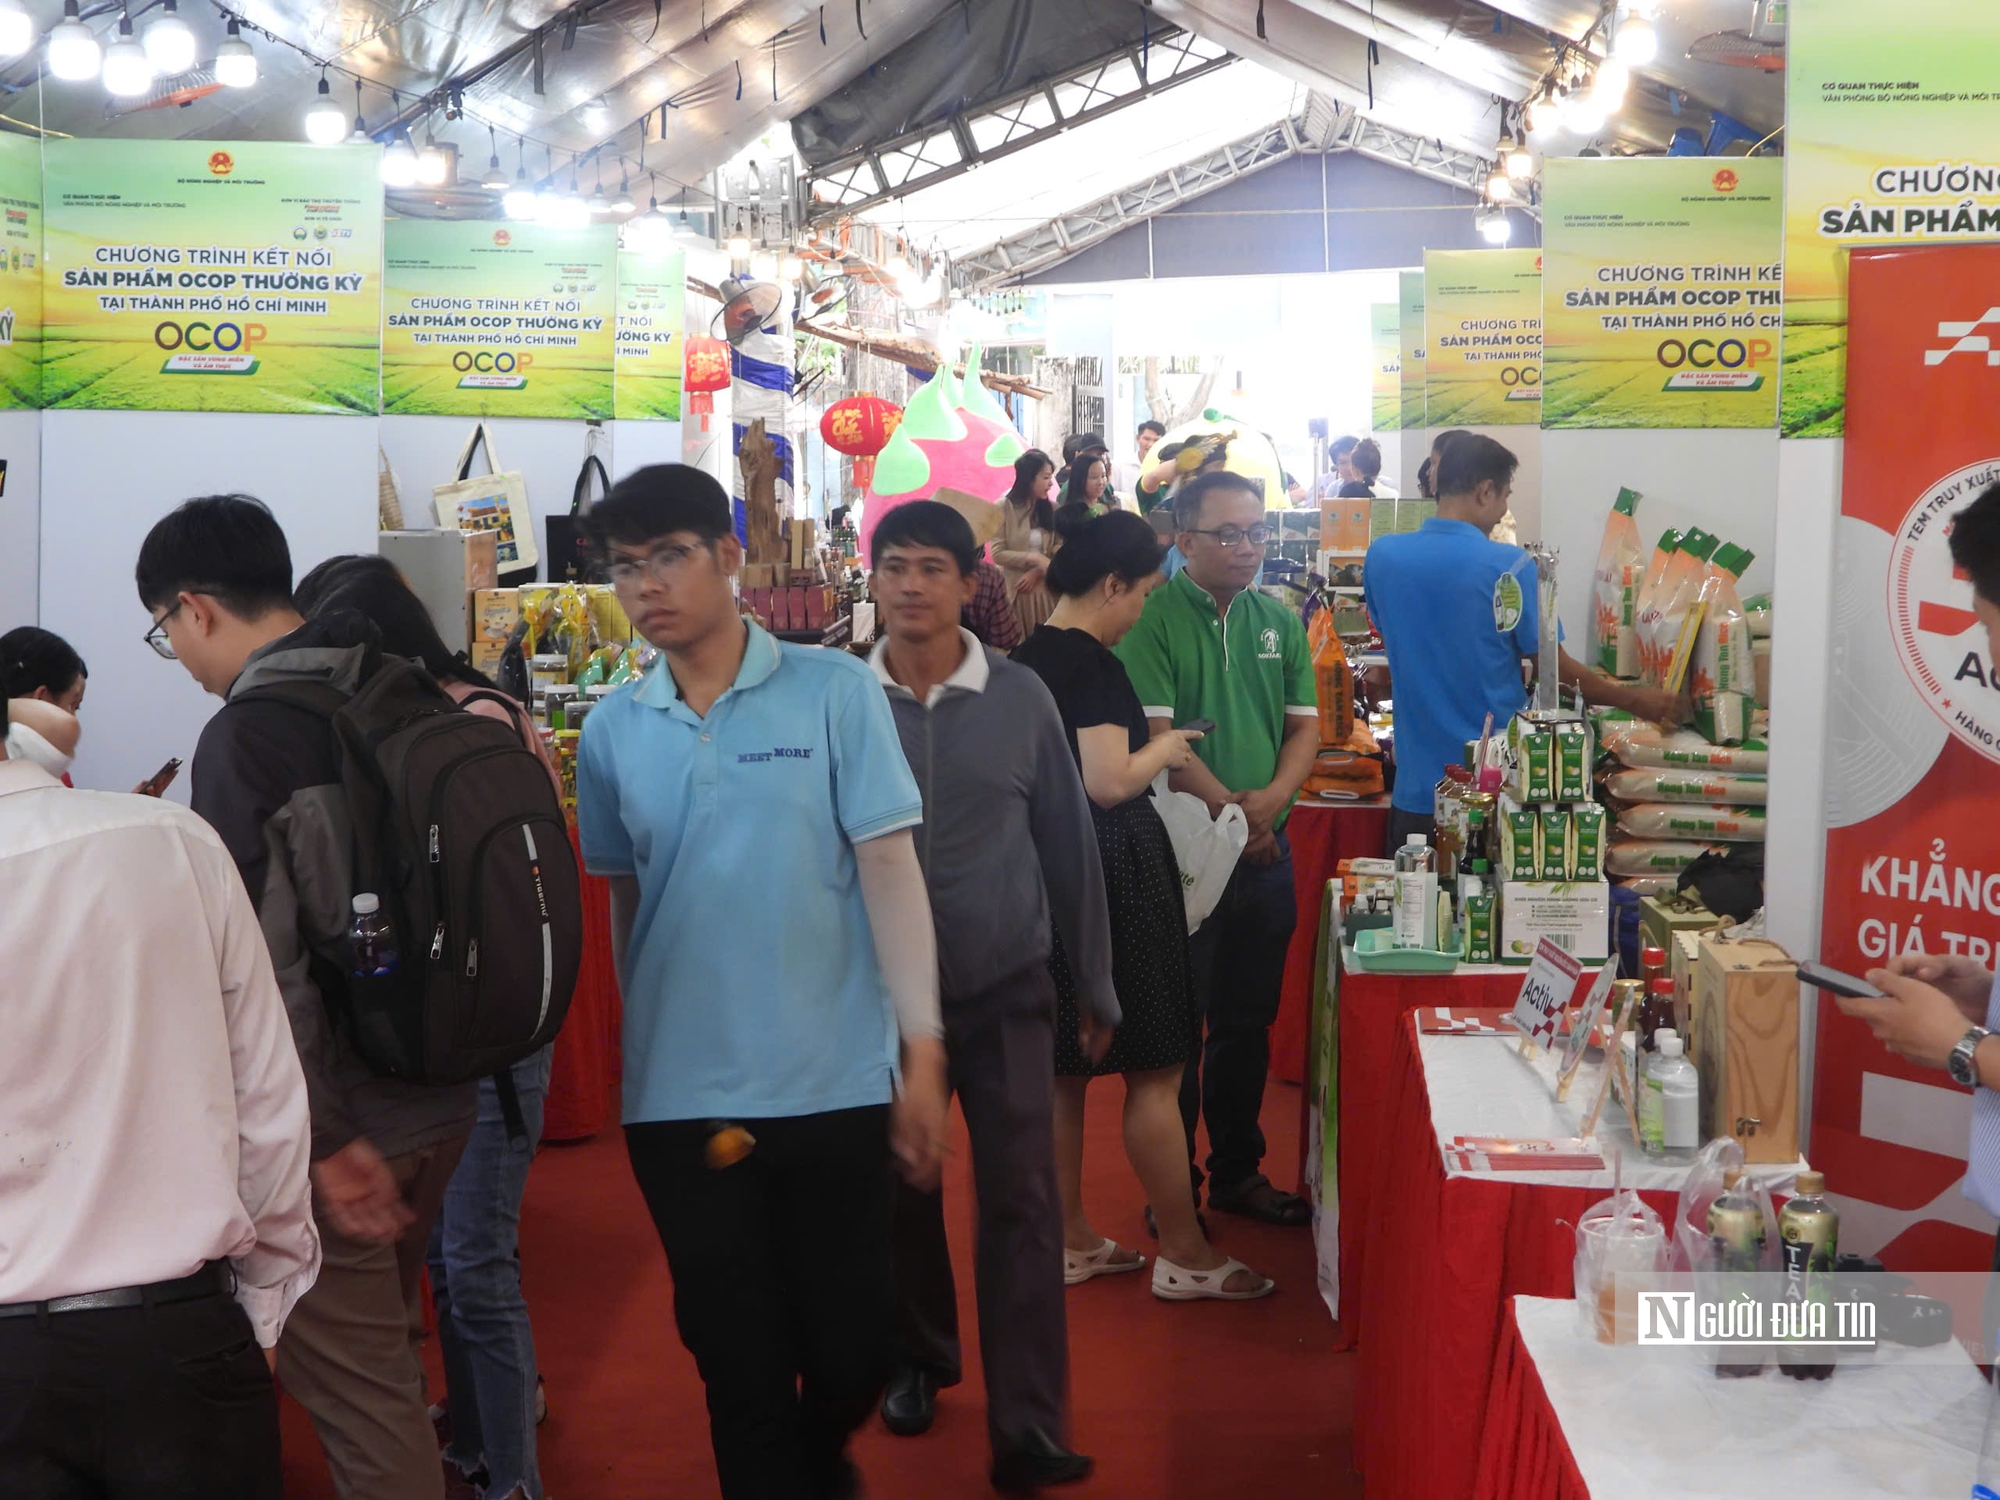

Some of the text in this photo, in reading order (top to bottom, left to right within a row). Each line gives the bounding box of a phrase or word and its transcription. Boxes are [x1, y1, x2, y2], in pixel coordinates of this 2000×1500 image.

[1822, 82, 1919, 90] CƠ QUAN THỰC HIỆN
[1876, 166, 2000, 193] CHƯƠN
[1822, 200, 2000, 233] SẢN PHẨM
[96, 245, 331, 266] CHƯƠNG TRÌNH KẾT NỐI
[64, 268, 363, 291] SẢN PHẨM OCOP THƯỜNG KỲ
[1598, 265, 1684, 282] CHƯƠNG
[1691, 265, 1751, 281] TRÌNH
[100, 295, 327, 313] TẠI THÀNH PHỐ HỒ CHÍ MINH
[411, 297, 581, 312] CHƯƠNG TRÌNH KẾT NỐI
[1565, 288, 1609, 306] SẢN
[1615, 287, 1676, 306] PHẨM
[1682, 291, 1740, 305] OCOP
[389, 313, 603, 330] SẢN PHẨM OCOP THƯỜNG KỲ
[1460, 319, 1517, 330] CHƯƠNG
[1602, 317, 1627, 330] TẠI
[1632, 313, 1688, 328] THÀNH
[1693, 312, 1727, 328] PHỐ
[1731, 312, 1755, 327] HỒ
[155, 321, 267, 352] OCOP
[414, 332, 577, 345] TẠI THÀNH PHỐ HỒ CHÍ MINH
[1440, 334, 1469, 347] SẢN
[1472, 333, 1511, 345] PHẨM
[623, 347, 649, 356] MINH
[1464, 352, 1481, 361] TẠI
[1484, 351, 1520, 360] THÀNH
[1657, 339, 1772, 368] OCOP
[453, 351, 533, 373] OCOP
[1501, 367, 1541, 386] OC
[1908, 513, 1932, 541] TEM
[1927, 482, 1965, 515] TRUY
[1955, 711, 1993, 745] HÀNG
[737, 748, 810, 763] MEET MORE
[1861, 838, 2000, 916] KHẲNG
[1858, 914, 1926, 962] GIÁ
[1786, 1245, 1801, 1300] TEA
